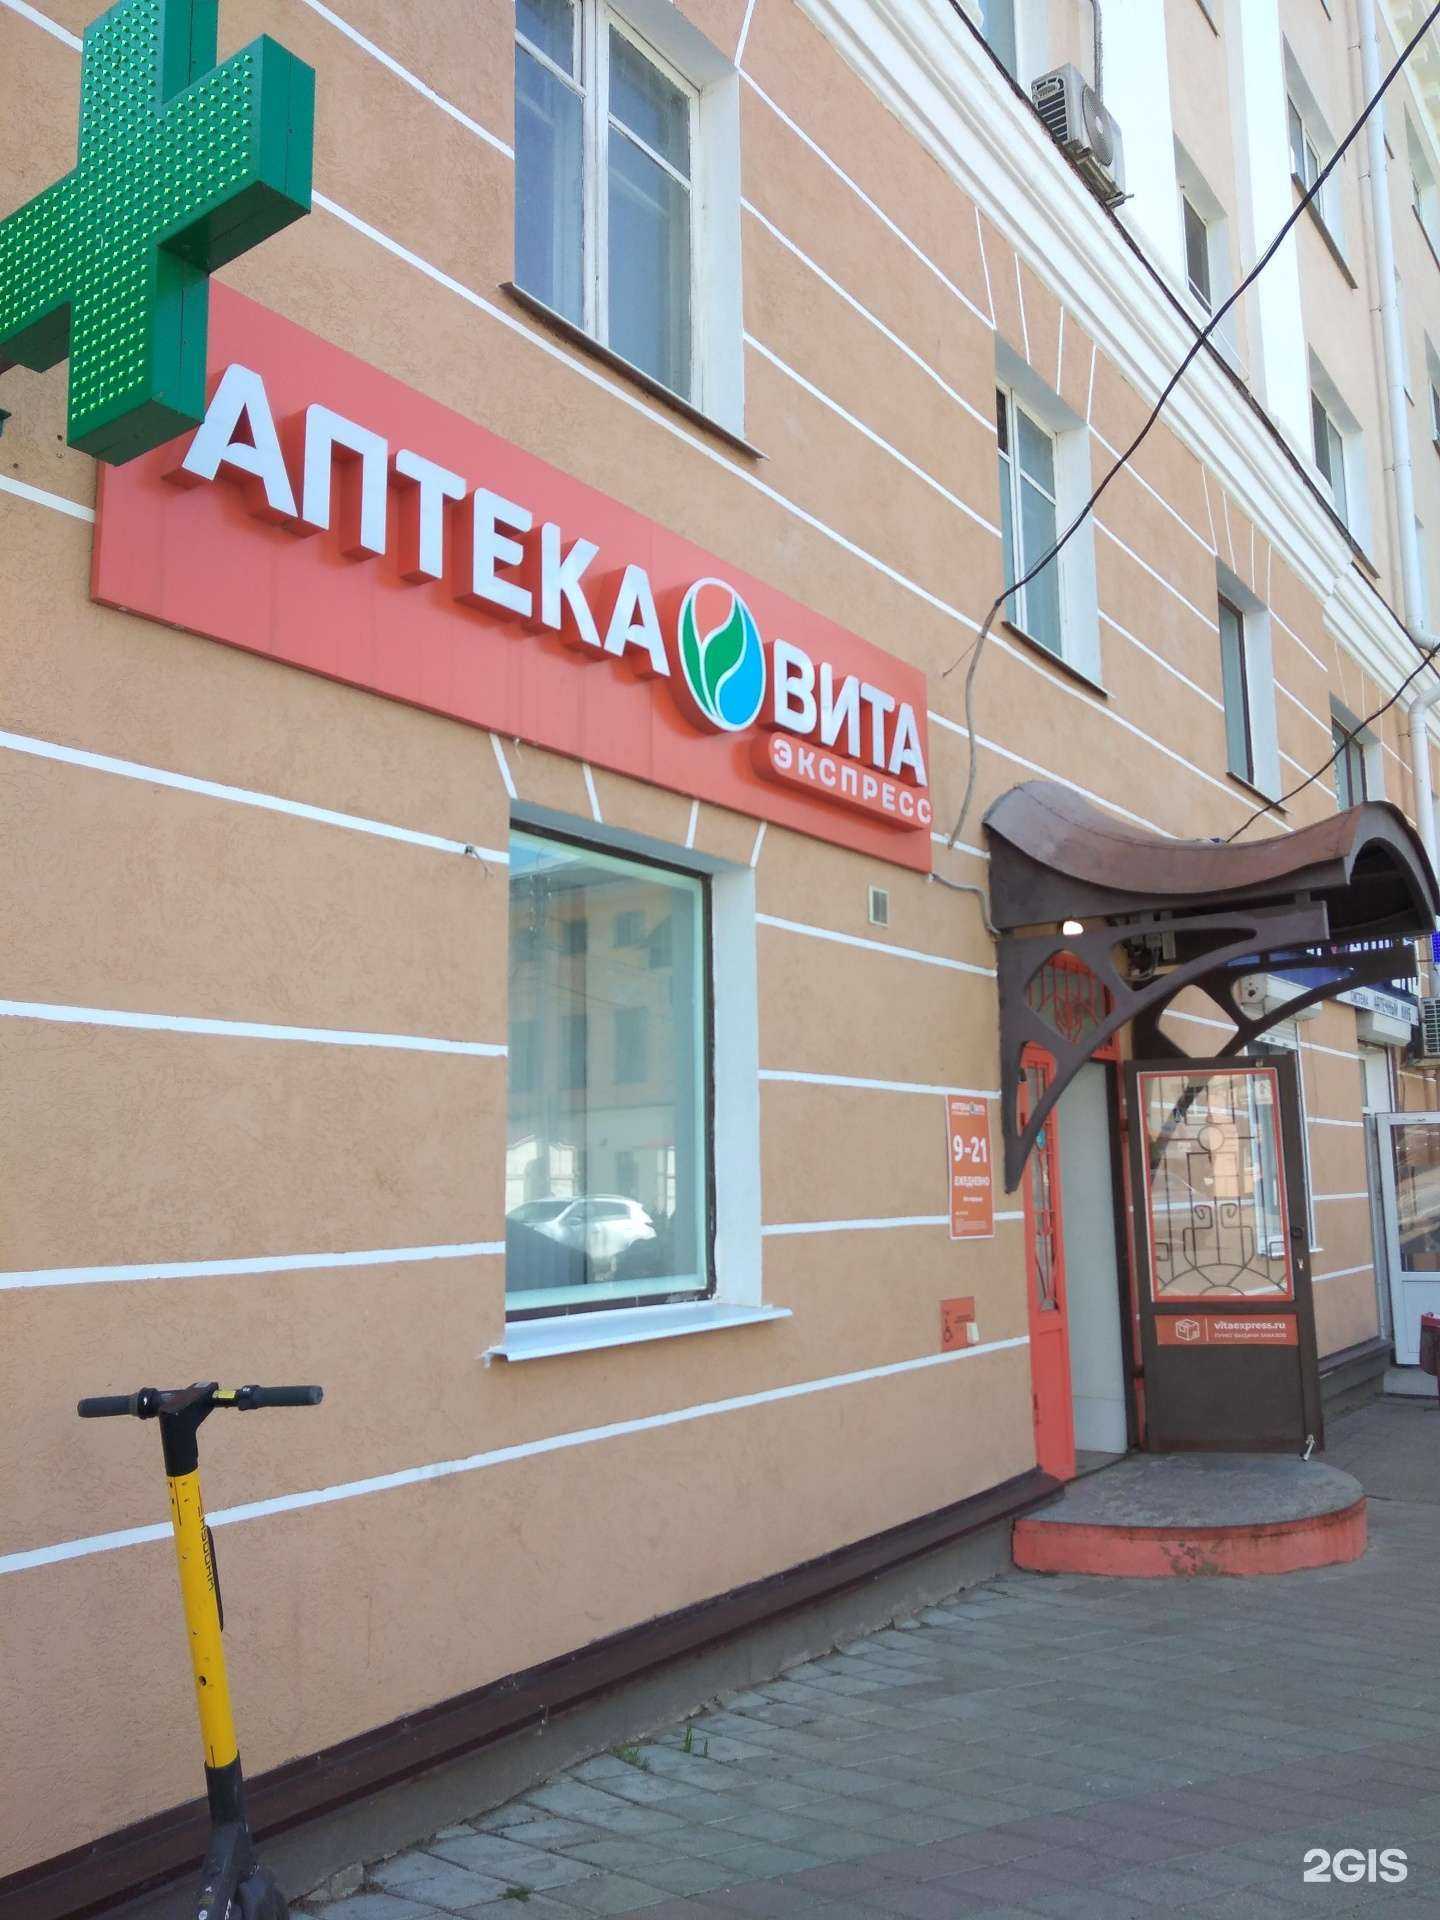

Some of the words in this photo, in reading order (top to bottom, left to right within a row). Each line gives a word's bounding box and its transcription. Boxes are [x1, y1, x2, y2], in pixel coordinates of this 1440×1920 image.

[181, 362, 671, 678] АПТЕКА
[773, 638, 929, 788] ВИТА
[773, 738, 932, 824] ЭКСПРЕСС
[952, 1134, 988, 1163] 9-21
[1214, 1320, 1286, 1331] vitaexpress.ru
